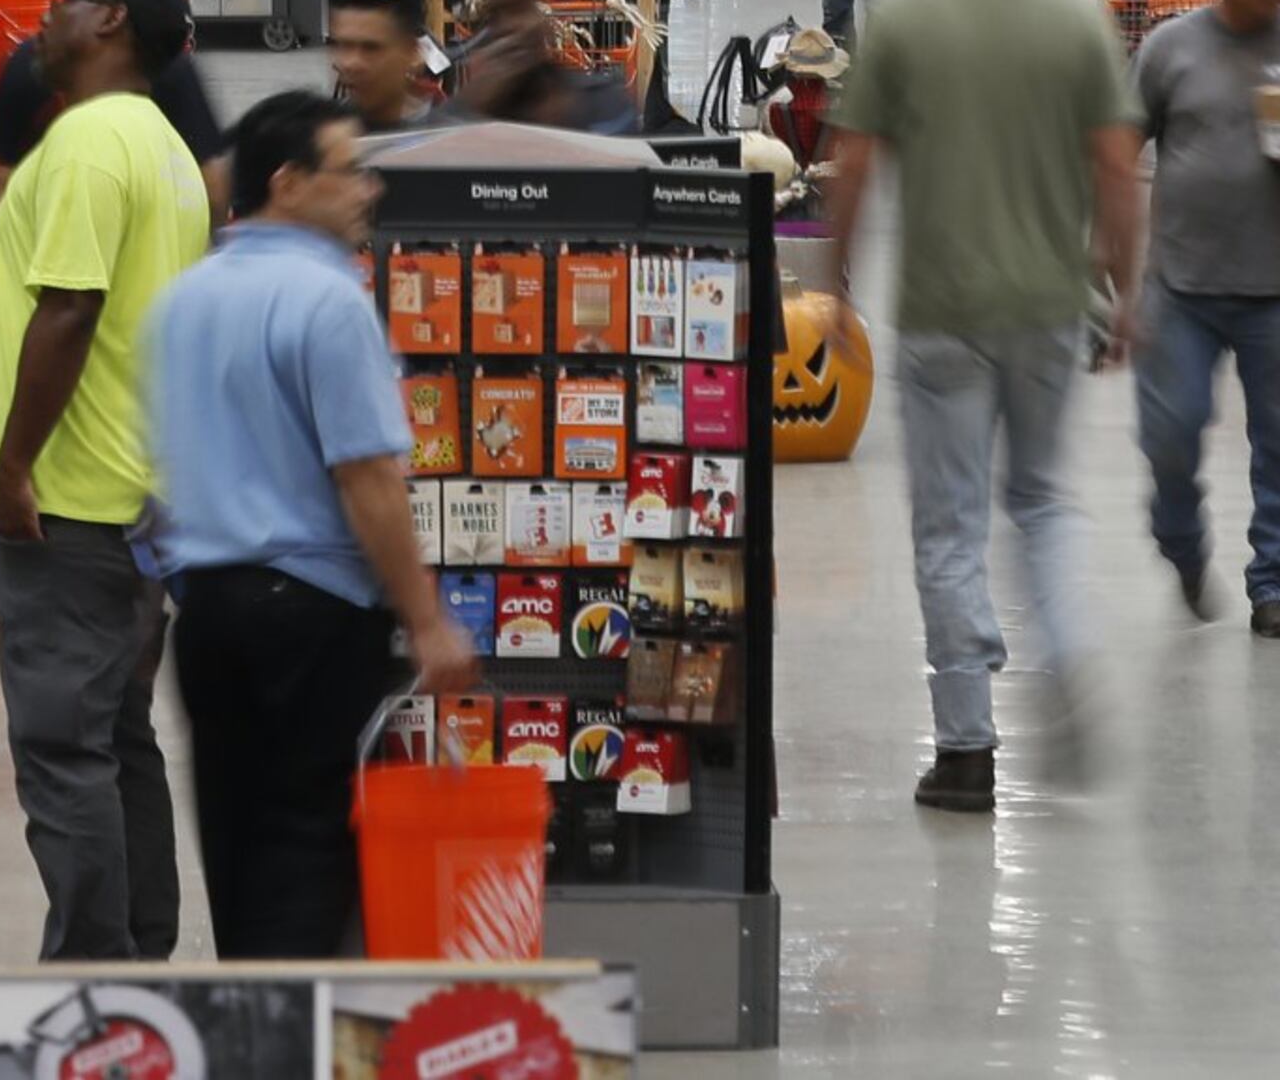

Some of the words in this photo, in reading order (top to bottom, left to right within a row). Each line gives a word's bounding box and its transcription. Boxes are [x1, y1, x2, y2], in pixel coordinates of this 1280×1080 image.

[471, 184, 518, 201] Dining
[520, 185, 549, 200] Out
[653, 185, 707, 204] Anywhere
[708, 187, 742, 205] Cards
[450, 502, 498, 518] BARNES
[462, 518, 498, 533] NOBLE
[578, 587, 628, 603] REGAL
[501, 598, 553, 614] amc
[507, 722, 560, 738] amc
